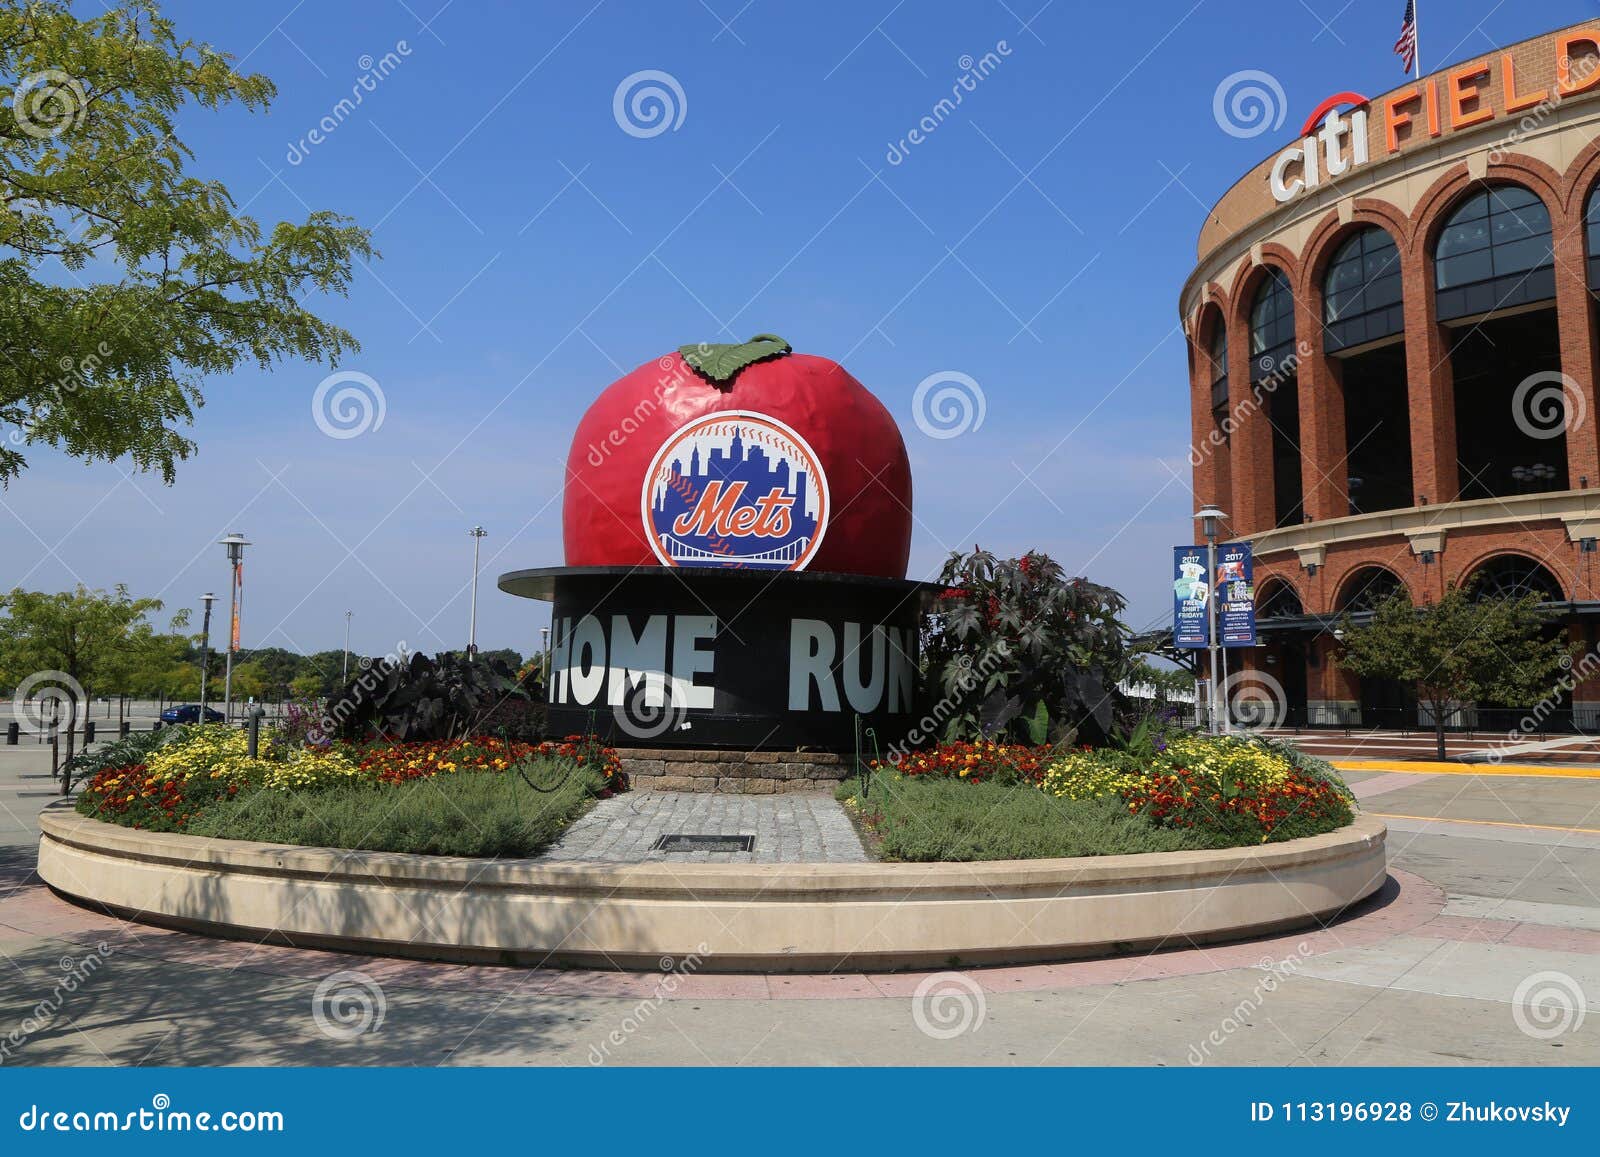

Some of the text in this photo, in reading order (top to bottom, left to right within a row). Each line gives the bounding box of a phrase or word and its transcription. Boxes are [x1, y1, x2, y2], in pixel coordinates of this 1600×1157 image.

[1270, 30, 1600, 202] citi FIELD
[672, 480, 797, 539] Mets
[1182, 556, 1200, 564] 2017
[1225, 553, 1244, 561] 2017
[549, 615, 914, 714] HOME RUN
